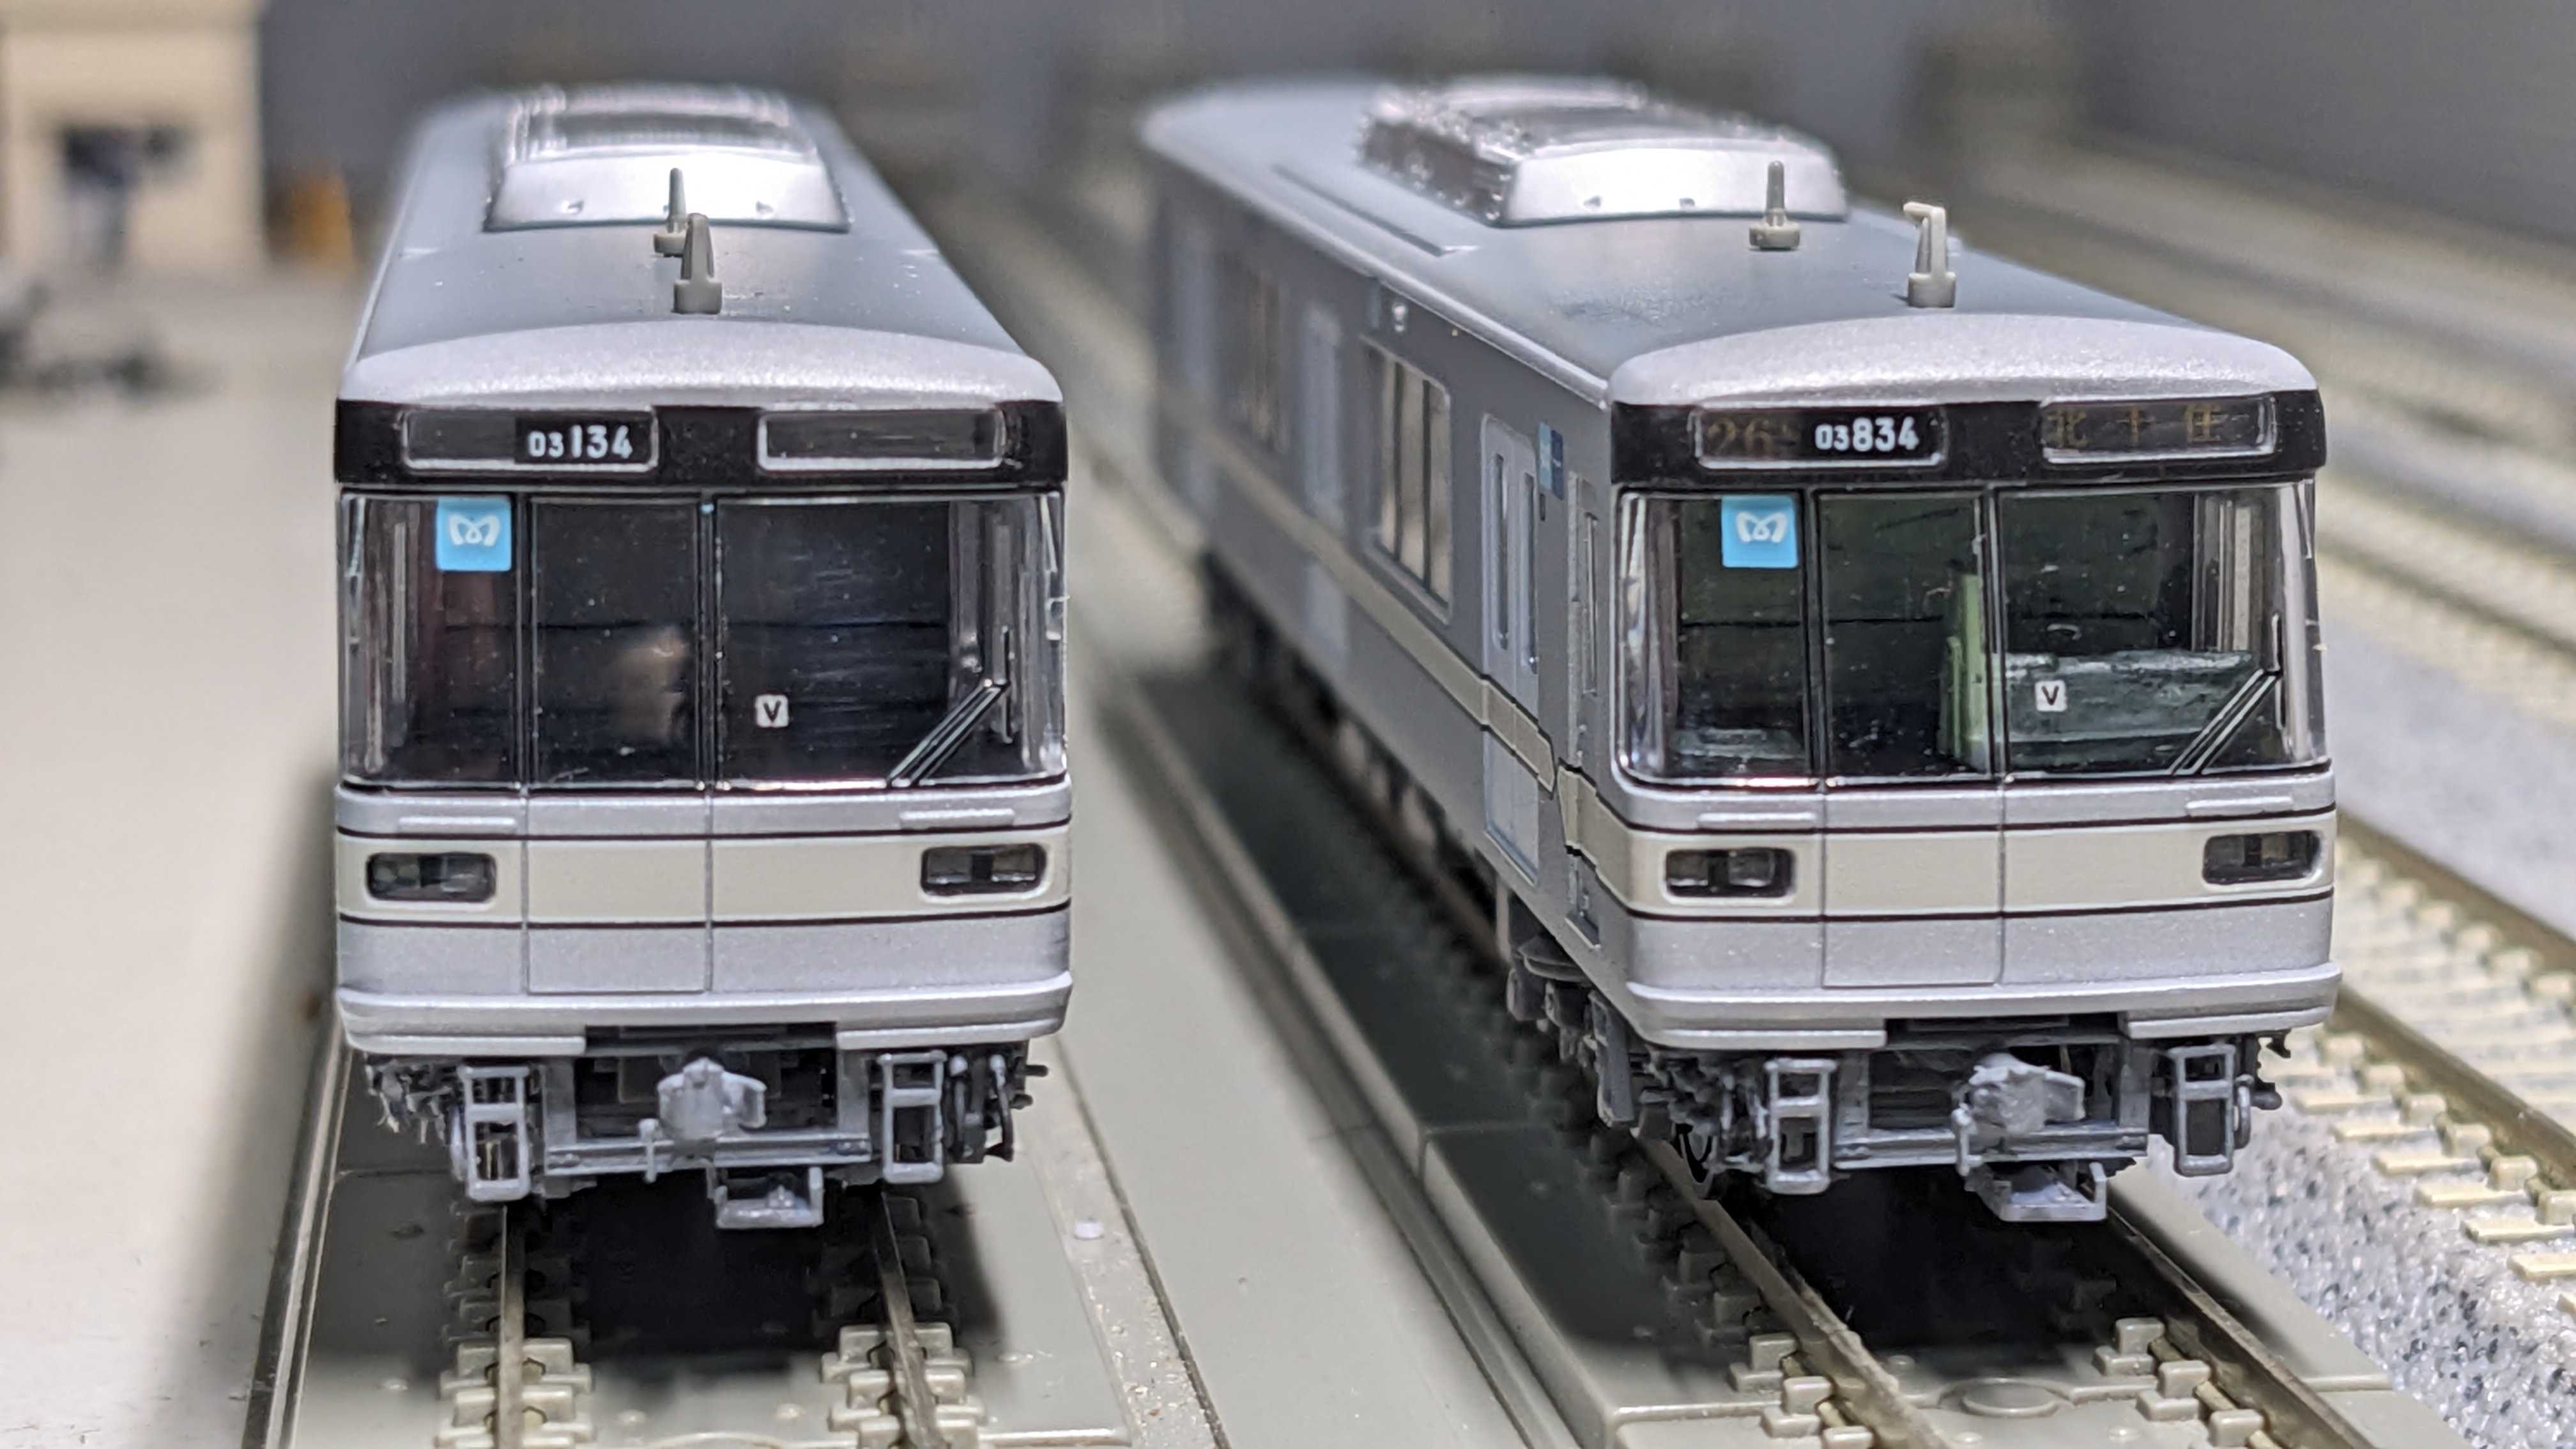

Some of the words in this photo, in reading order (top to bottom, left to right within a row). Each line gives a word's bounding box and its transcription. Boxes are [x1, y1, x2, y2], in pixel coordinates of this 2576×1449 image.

[528, 424, 632, 459] 03134
[1815, 417, 1920, 452] 03834
[2041, 685, 2059, 706] V
[763, 700, 781, 723] V
